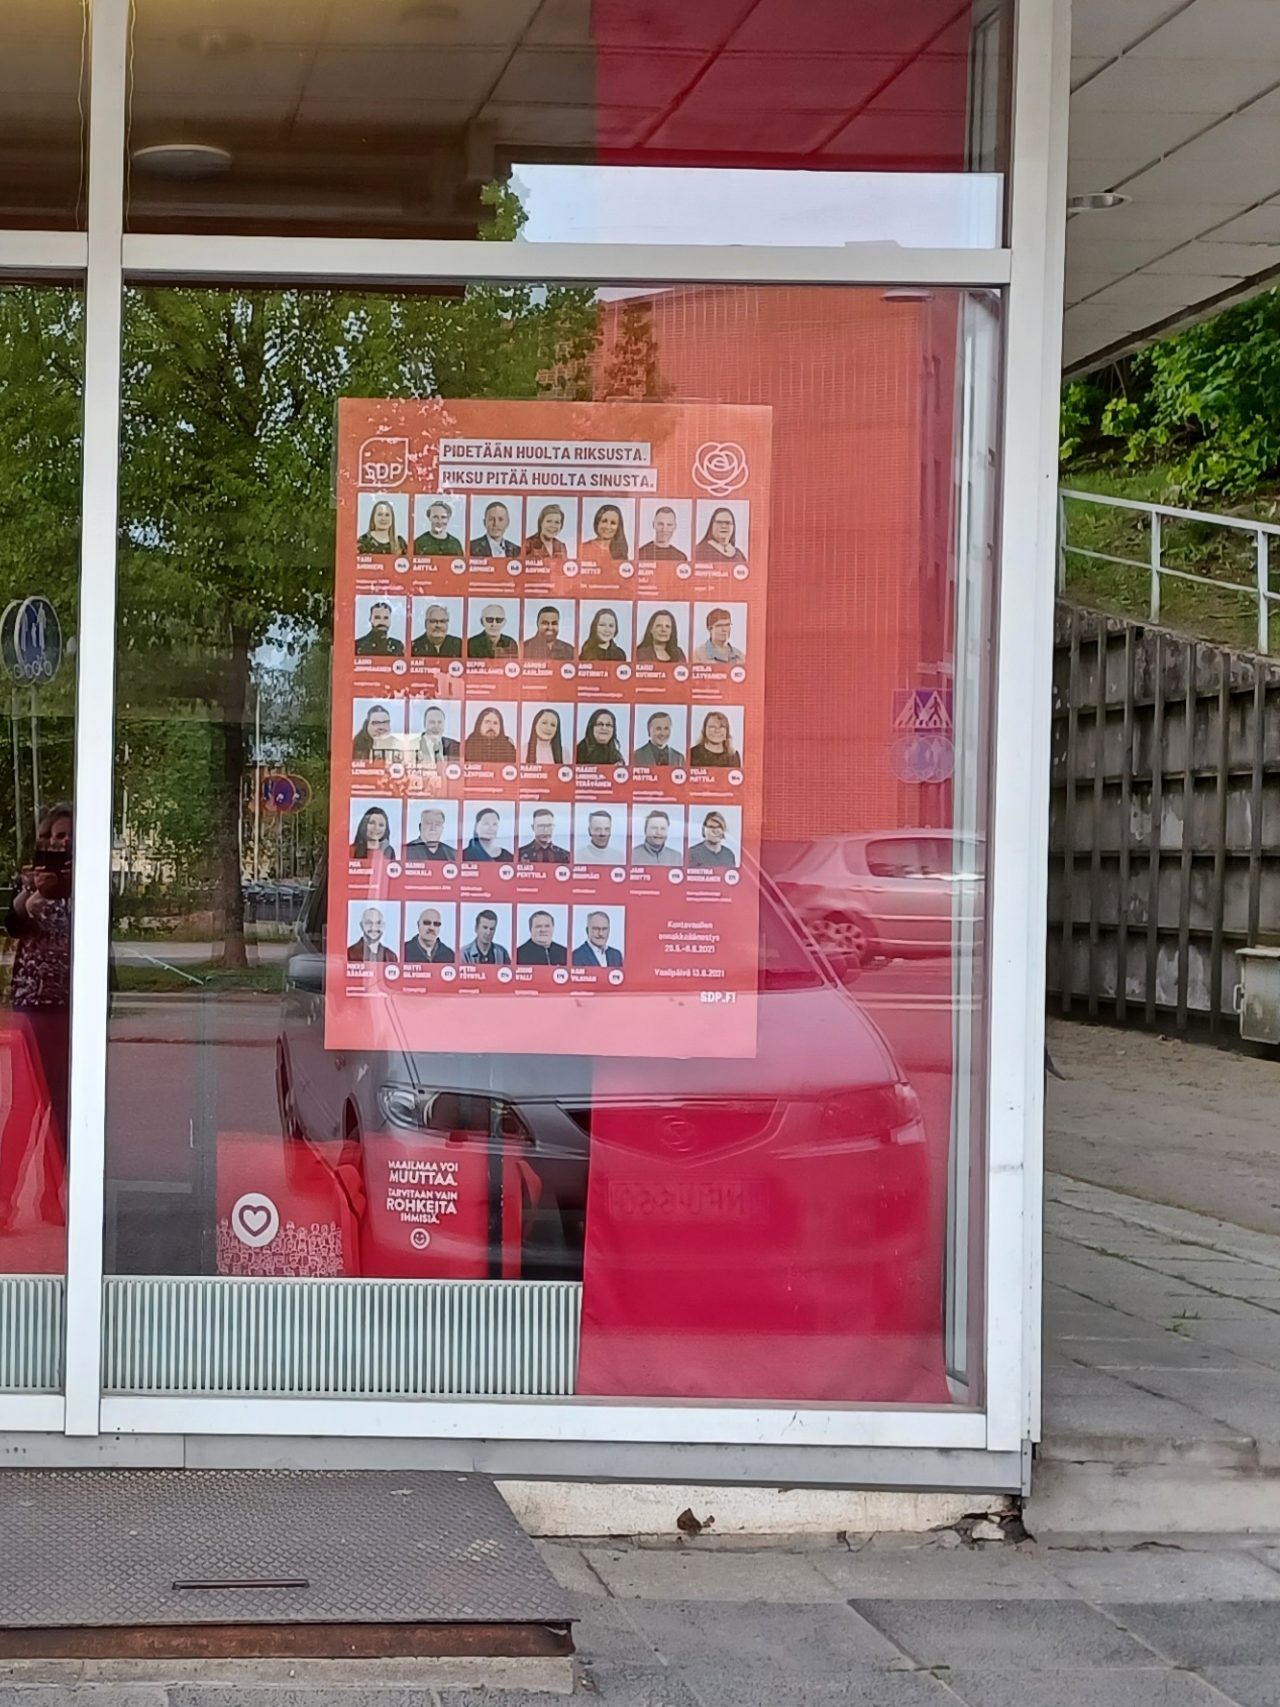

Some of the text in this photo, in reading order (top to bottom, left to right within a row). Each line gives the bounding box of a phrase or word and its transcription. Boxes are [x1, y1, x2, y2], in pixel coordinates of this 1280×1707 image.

[443, 442, 647, 461] PIDETÄÄN HUOLTA RIKSUSTA.
[364, 462, 403, 480] SDP
[442, 469, 654, 488] RIKSU PITÄÄ HUOLTA SINUSTA.
[700, 991, 736, 1003] SDP.FI
[440, 1162, 458, 1172] VOI
[434, 1190, 458, 1201] VAIN
[386, 1198, 458, 1215] ROHKEITA
